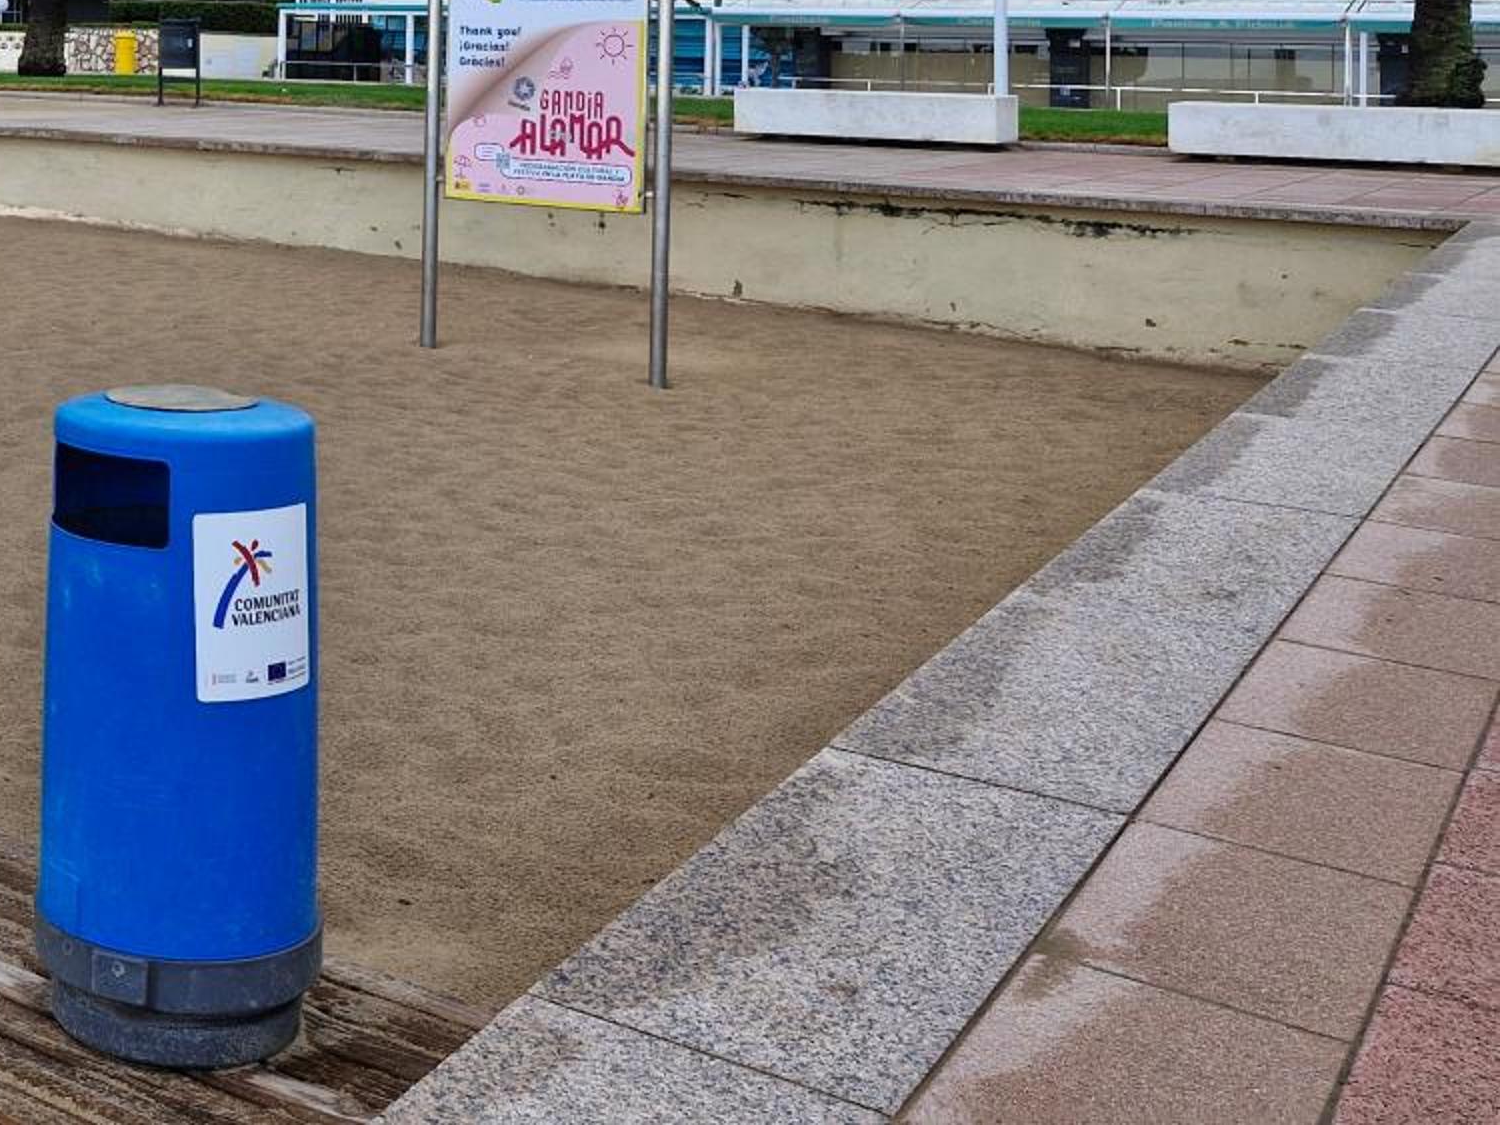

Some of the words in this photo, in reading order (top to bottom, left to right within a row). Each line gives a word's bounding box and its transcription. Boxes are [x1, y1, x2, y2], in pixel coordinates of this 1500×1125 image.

[459, 26, 493, 36] Thank
[497, 26, 522, 40] you!
[459, 41, 510, 52] ¡Gracias!
[234, 588, 300, 612] COMUNITAT
[231, 604, 301, 627] VALENCIANA
